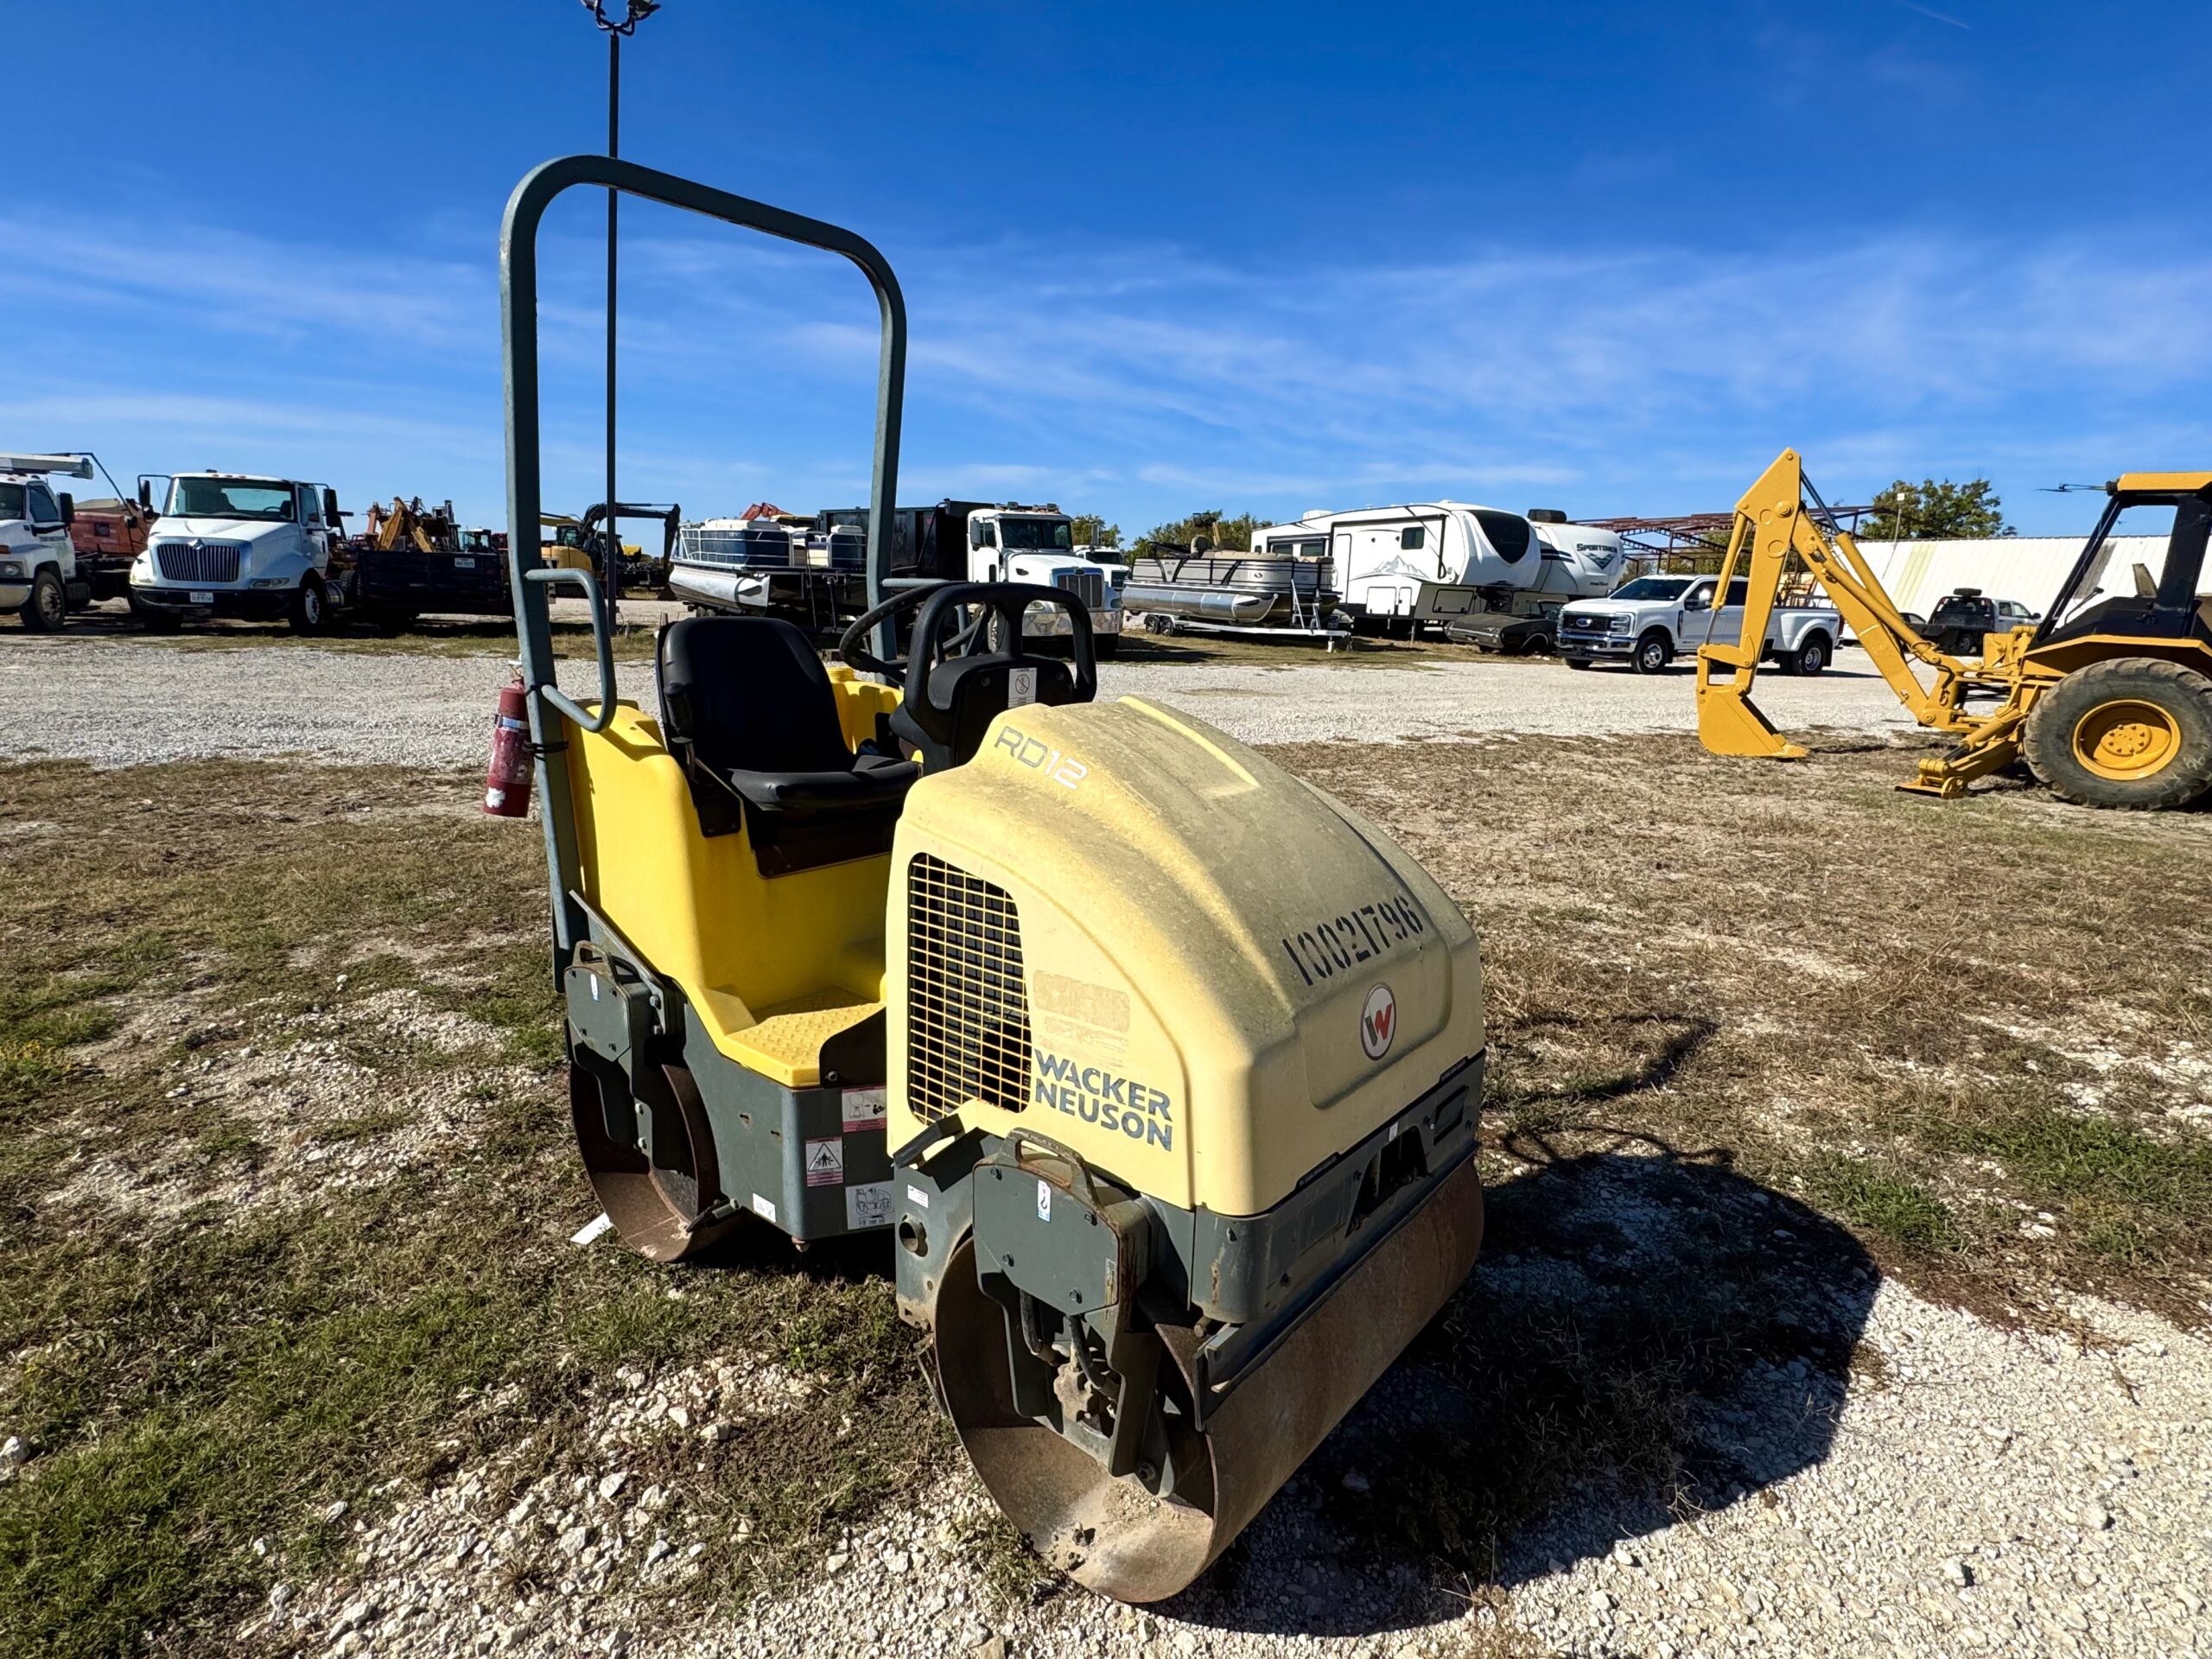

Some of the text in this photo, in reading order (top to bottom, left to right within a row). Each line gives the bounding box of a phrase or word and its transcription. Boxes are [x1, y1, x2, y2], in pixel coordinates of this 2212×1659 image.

[994, 726, 1088, 790] RD12
[1282, 895, 1423, 986] 10021796
[1034, 1048, 1173, 1122] WACKER
[1035, 1077, 1173, 1152] NEUSON
